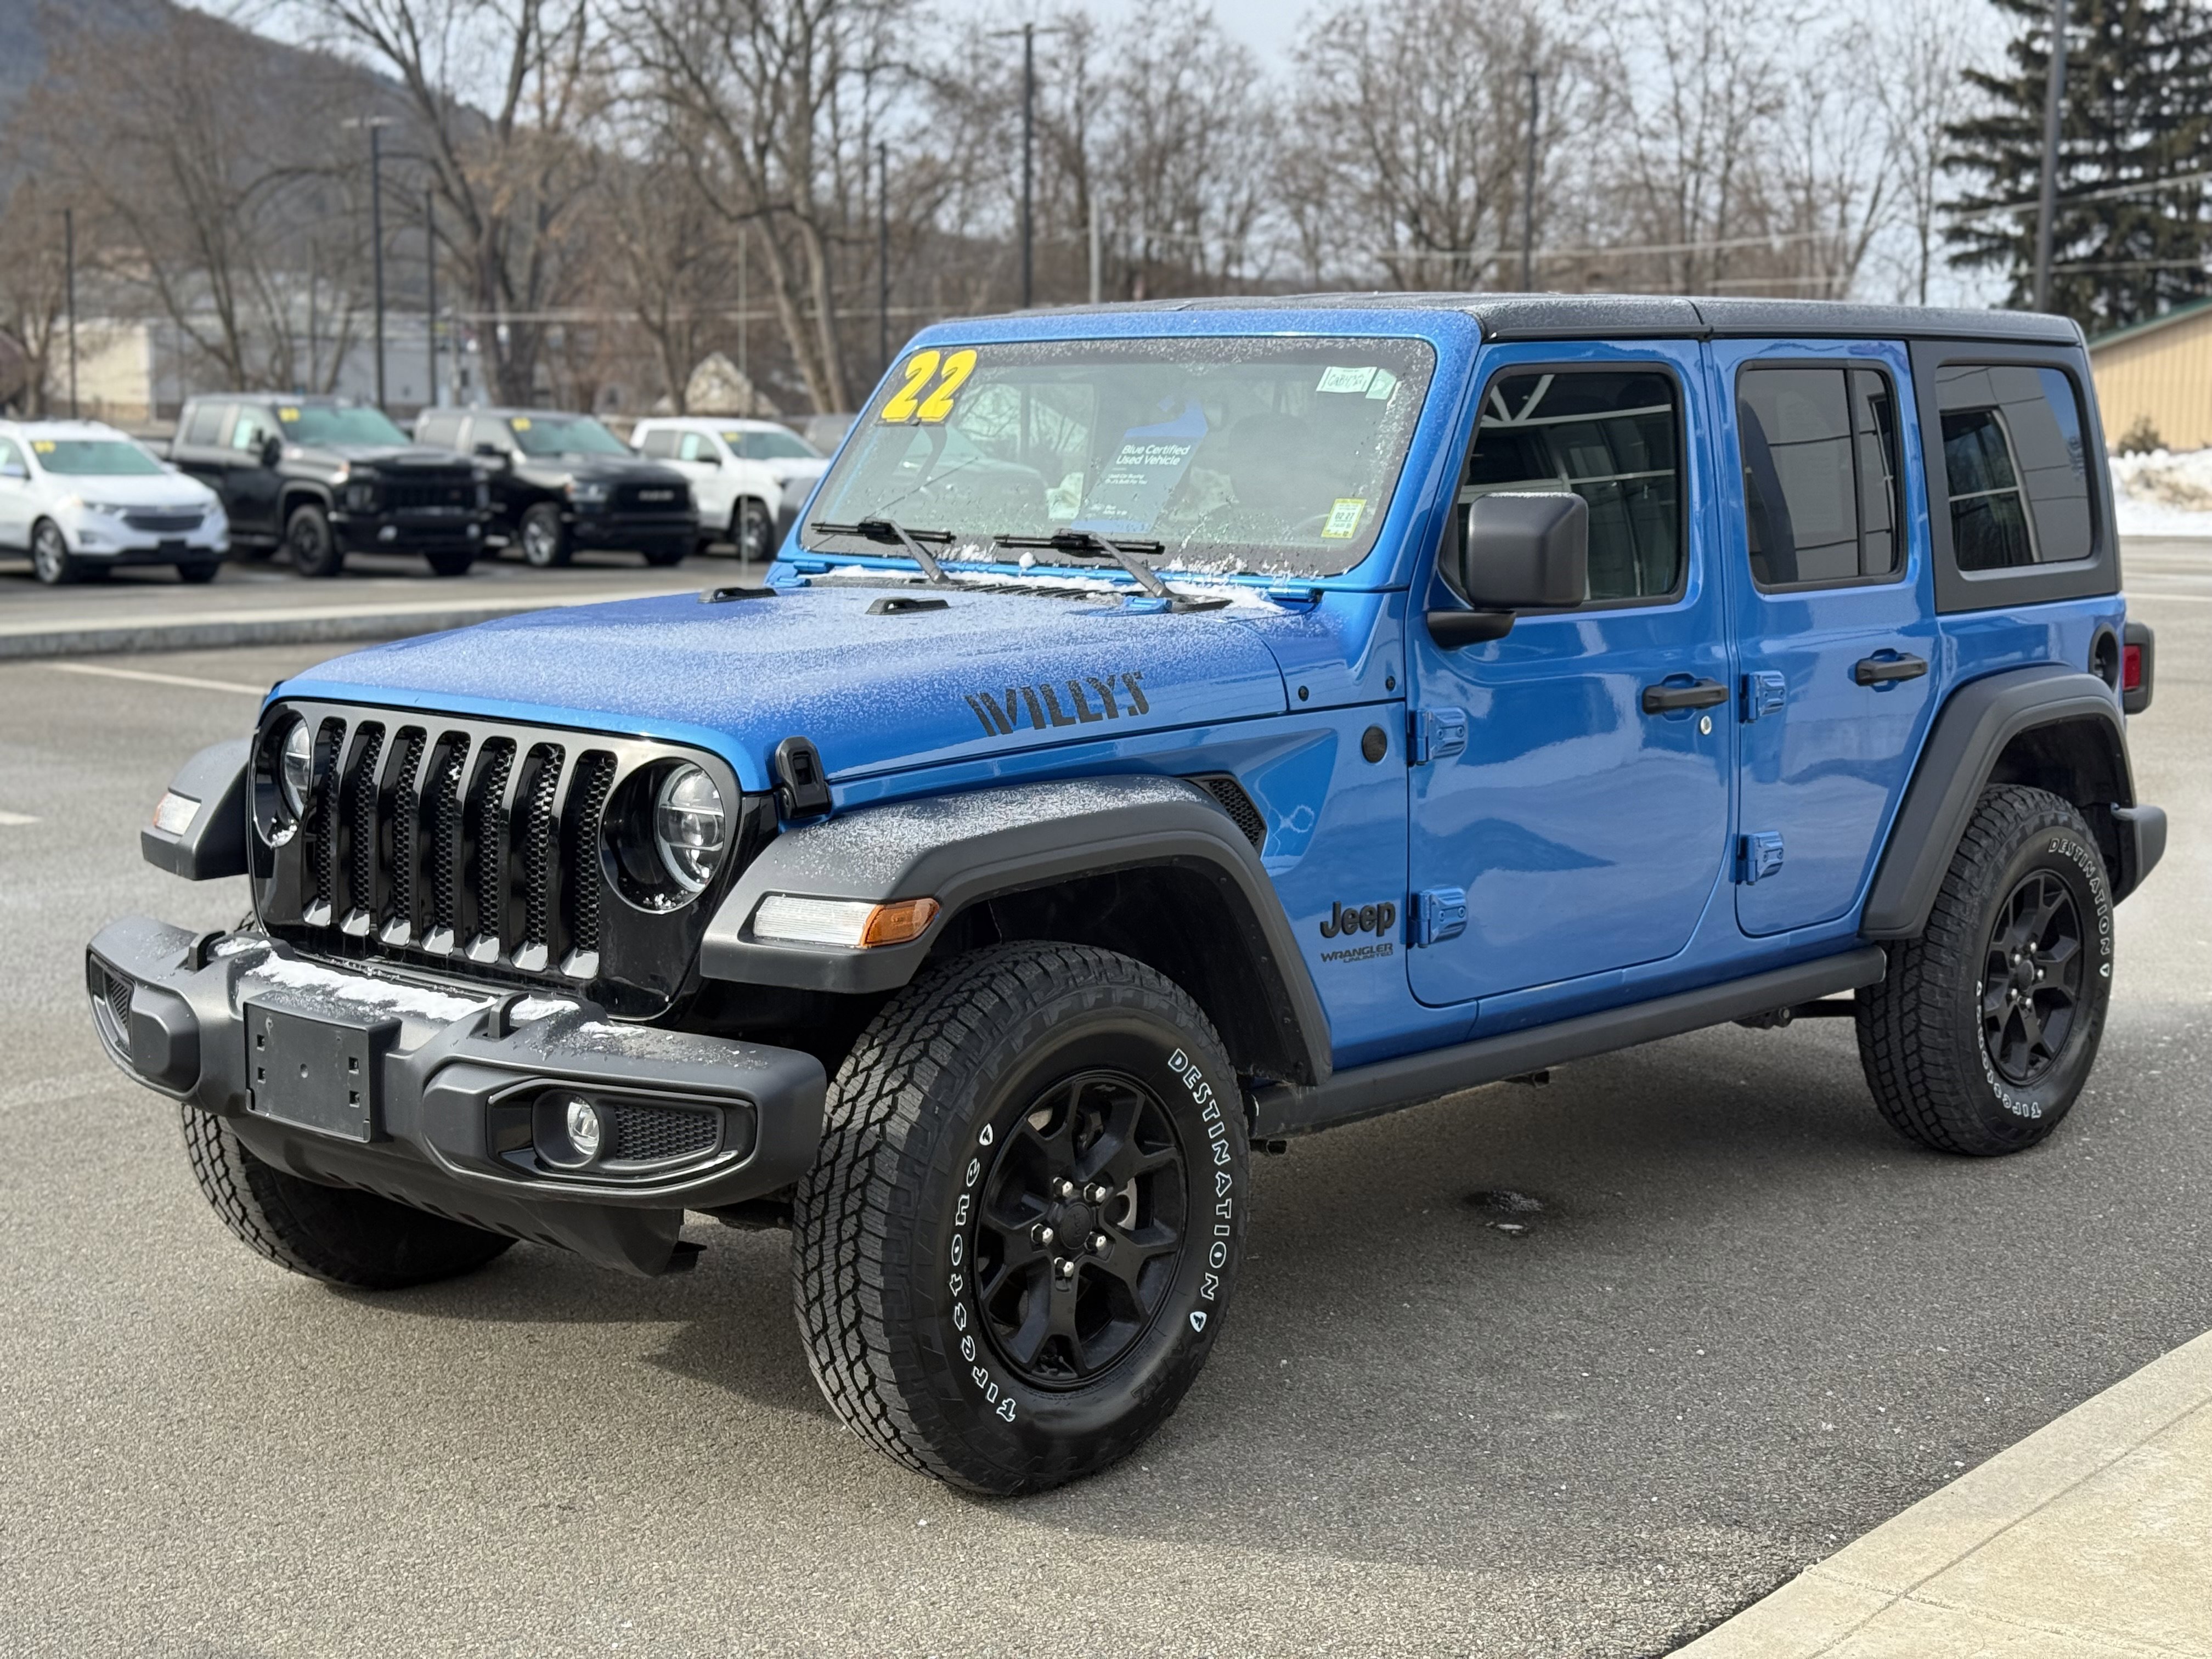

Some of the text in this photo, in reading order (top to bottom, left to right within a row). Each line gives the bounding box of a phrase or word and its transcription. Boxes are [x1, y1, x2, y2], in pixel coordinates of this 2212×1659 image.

[881, 350, 977, 422] 22
[1116, 455, 1181, 465] Used Vehicle
[1121, 444, 1191, 455] Blue Certified
[964, 670, 1150, 737] WILLYS
[2049, 838, 2111, 956] DESTINATION
[1320, 900, 1396, 939] Jeep
[1321, 943, 1393, 963] WRANGLER
[1343, 951, 1393, 963] UNLIMITED
[1169, 1048, 1232, 1301] DESTINATION
